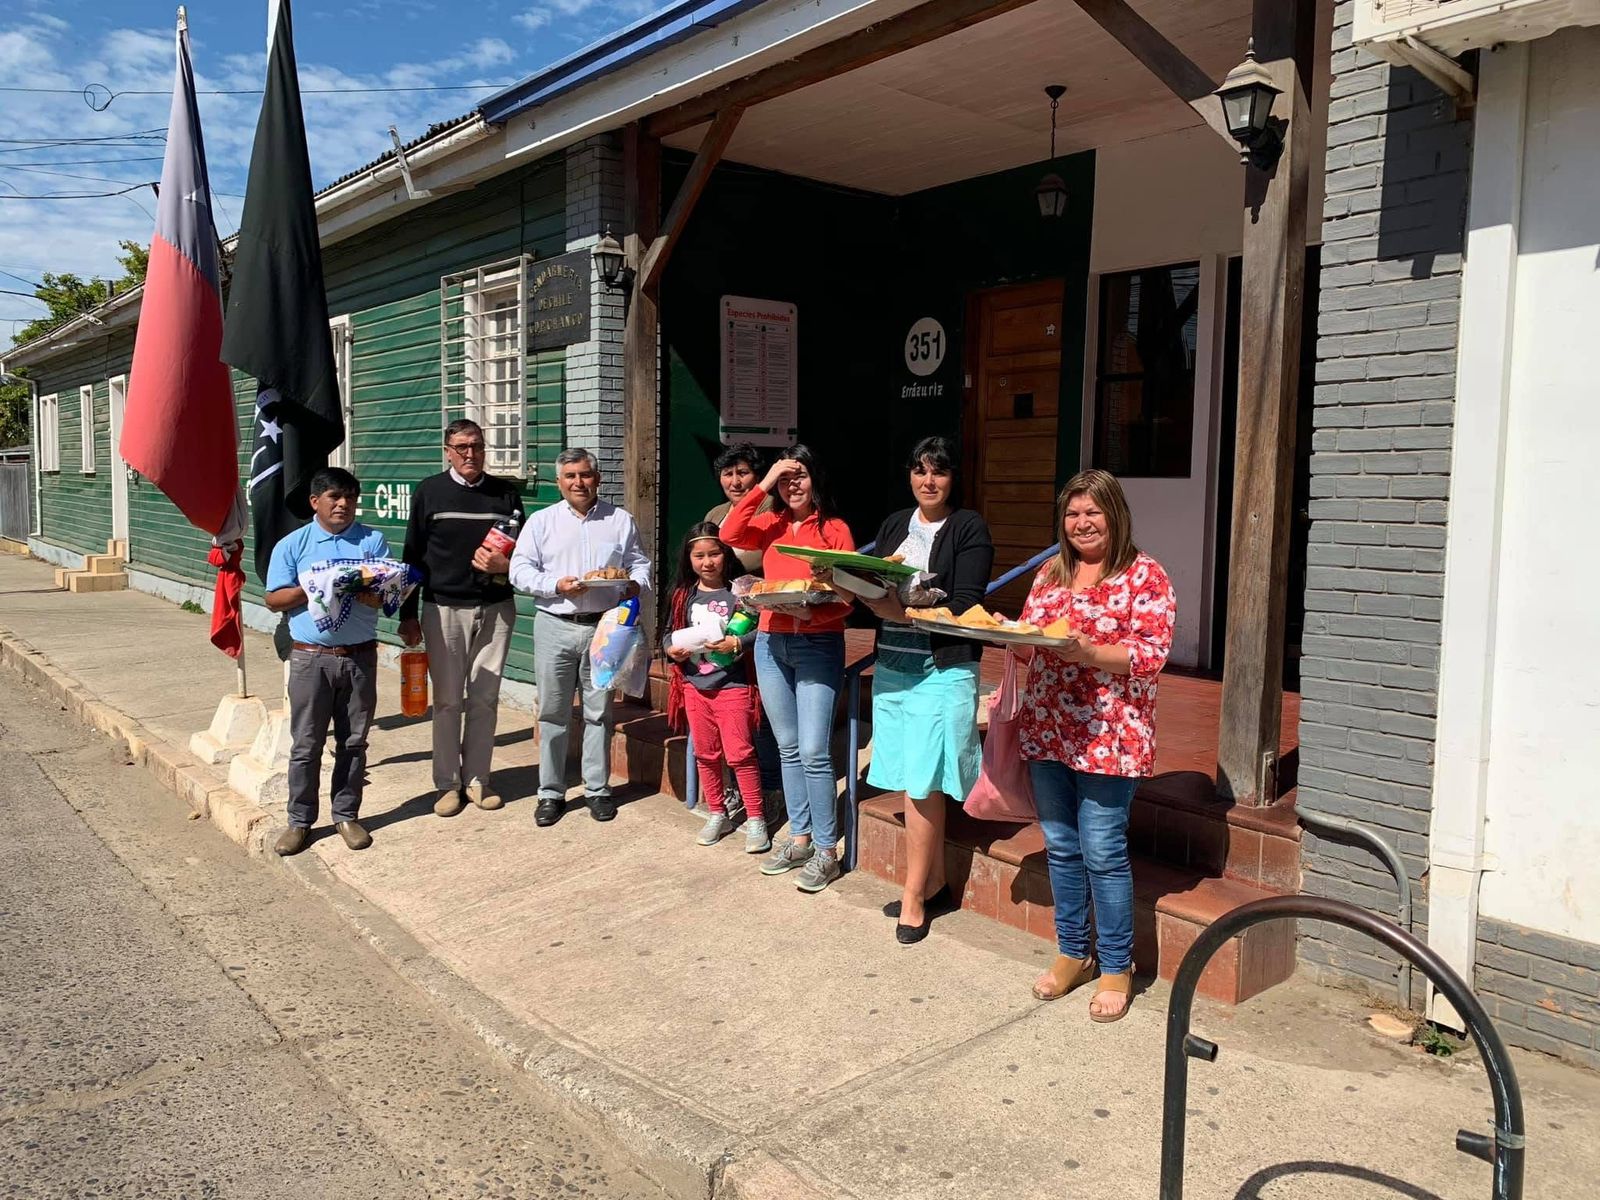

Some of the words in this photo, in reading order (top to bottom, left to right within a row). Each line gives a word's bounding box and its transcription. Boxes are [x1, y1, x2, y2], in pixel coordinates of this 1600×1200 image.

[727, 308, 755, 319] Especies
[757, 311, 791, 323] Prohibidas
[910, 330, 941, 361] 351
